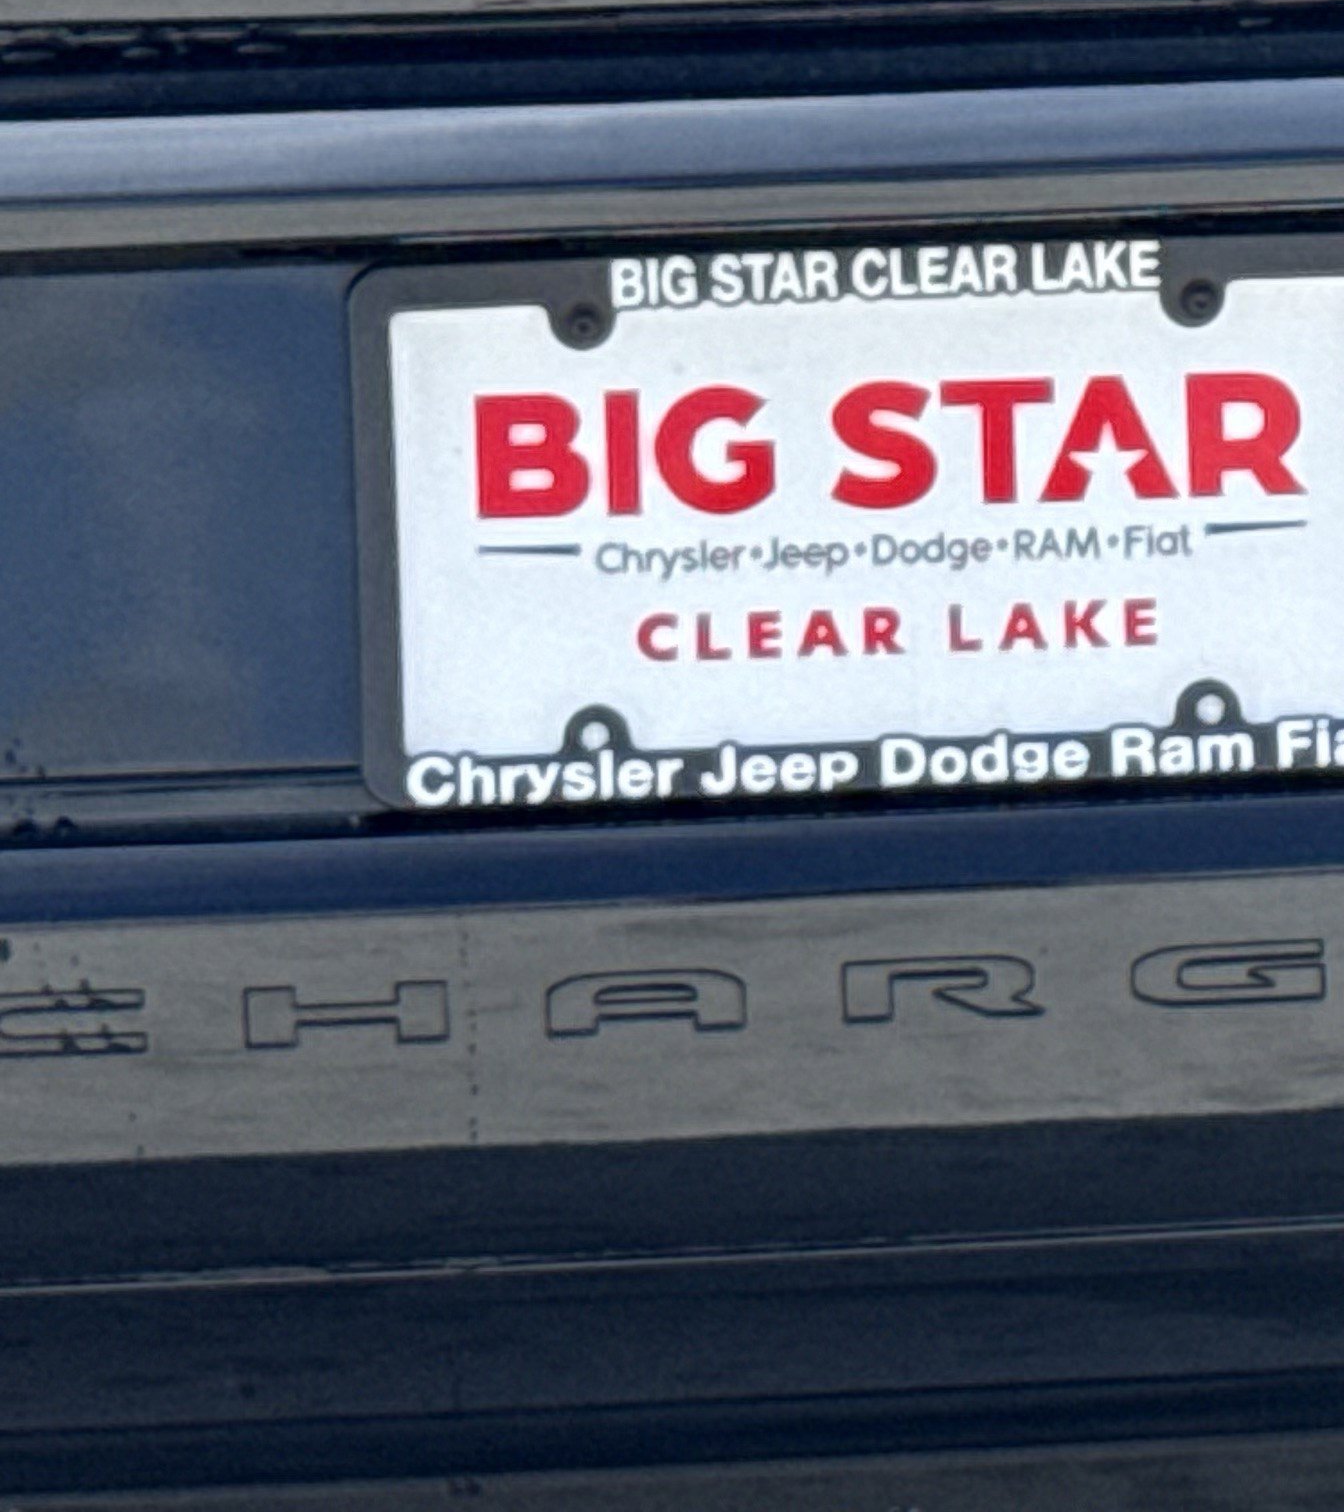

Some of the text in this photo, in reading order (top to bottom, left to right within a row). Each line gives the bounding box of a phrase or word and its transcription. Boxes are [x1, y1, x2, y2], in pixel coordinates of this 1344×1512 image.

[611, 240, 1161, 307] BIG STAR CLEAR LAKE
[474, 372, 1309, 519] BIG STAR
[636, 597, 1159, 662] CLEAR LAKE
[406, 748, 684, 807] Chrysler
[700, 743, 859, 796] Jeep
[879, 733, 1091, 787] Dodge
[1111, 726, 1255, 778] Ram
